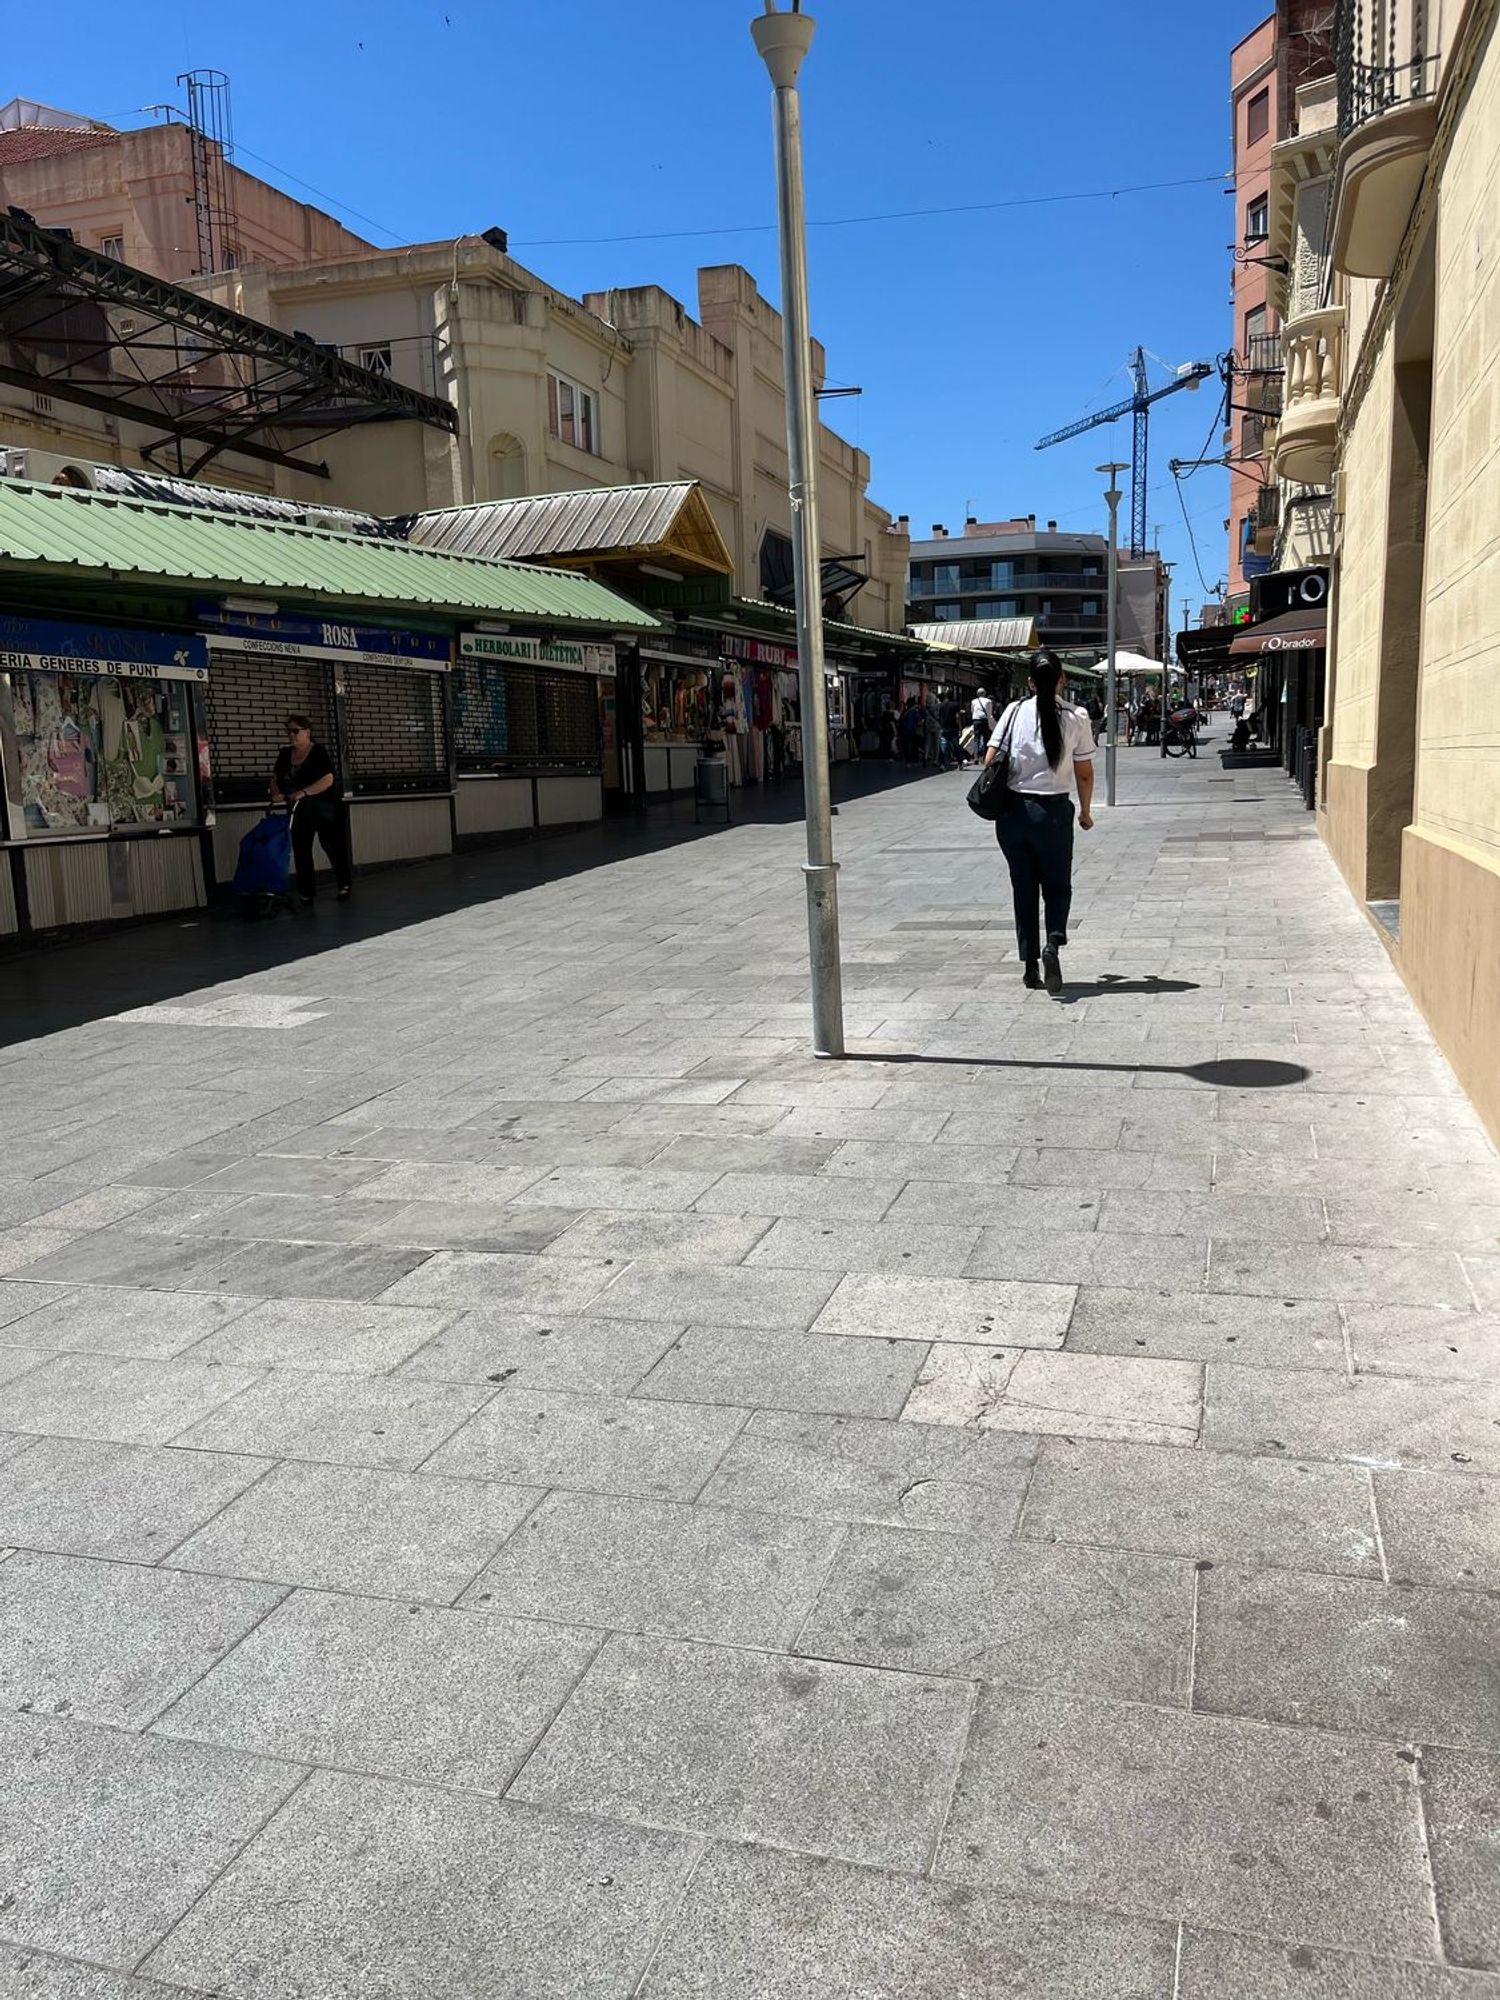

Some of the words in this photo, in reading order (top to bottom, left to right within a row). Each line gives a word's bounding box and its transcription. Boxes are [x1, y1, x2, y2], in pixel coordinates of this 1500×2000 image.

[242, 640, 284, 652] CONFECCIONS
[321, 623, 359, 648] ROSA
[474, 638, 531, 659] HERBOLARI
[533, 644, 538, 660] I
[757, 643, 786, 666] RUBI
[40, 656, 99, 673] GENERES
[107, 662, 122, 675] DE
[129, 664, 159, 677] PUNT
